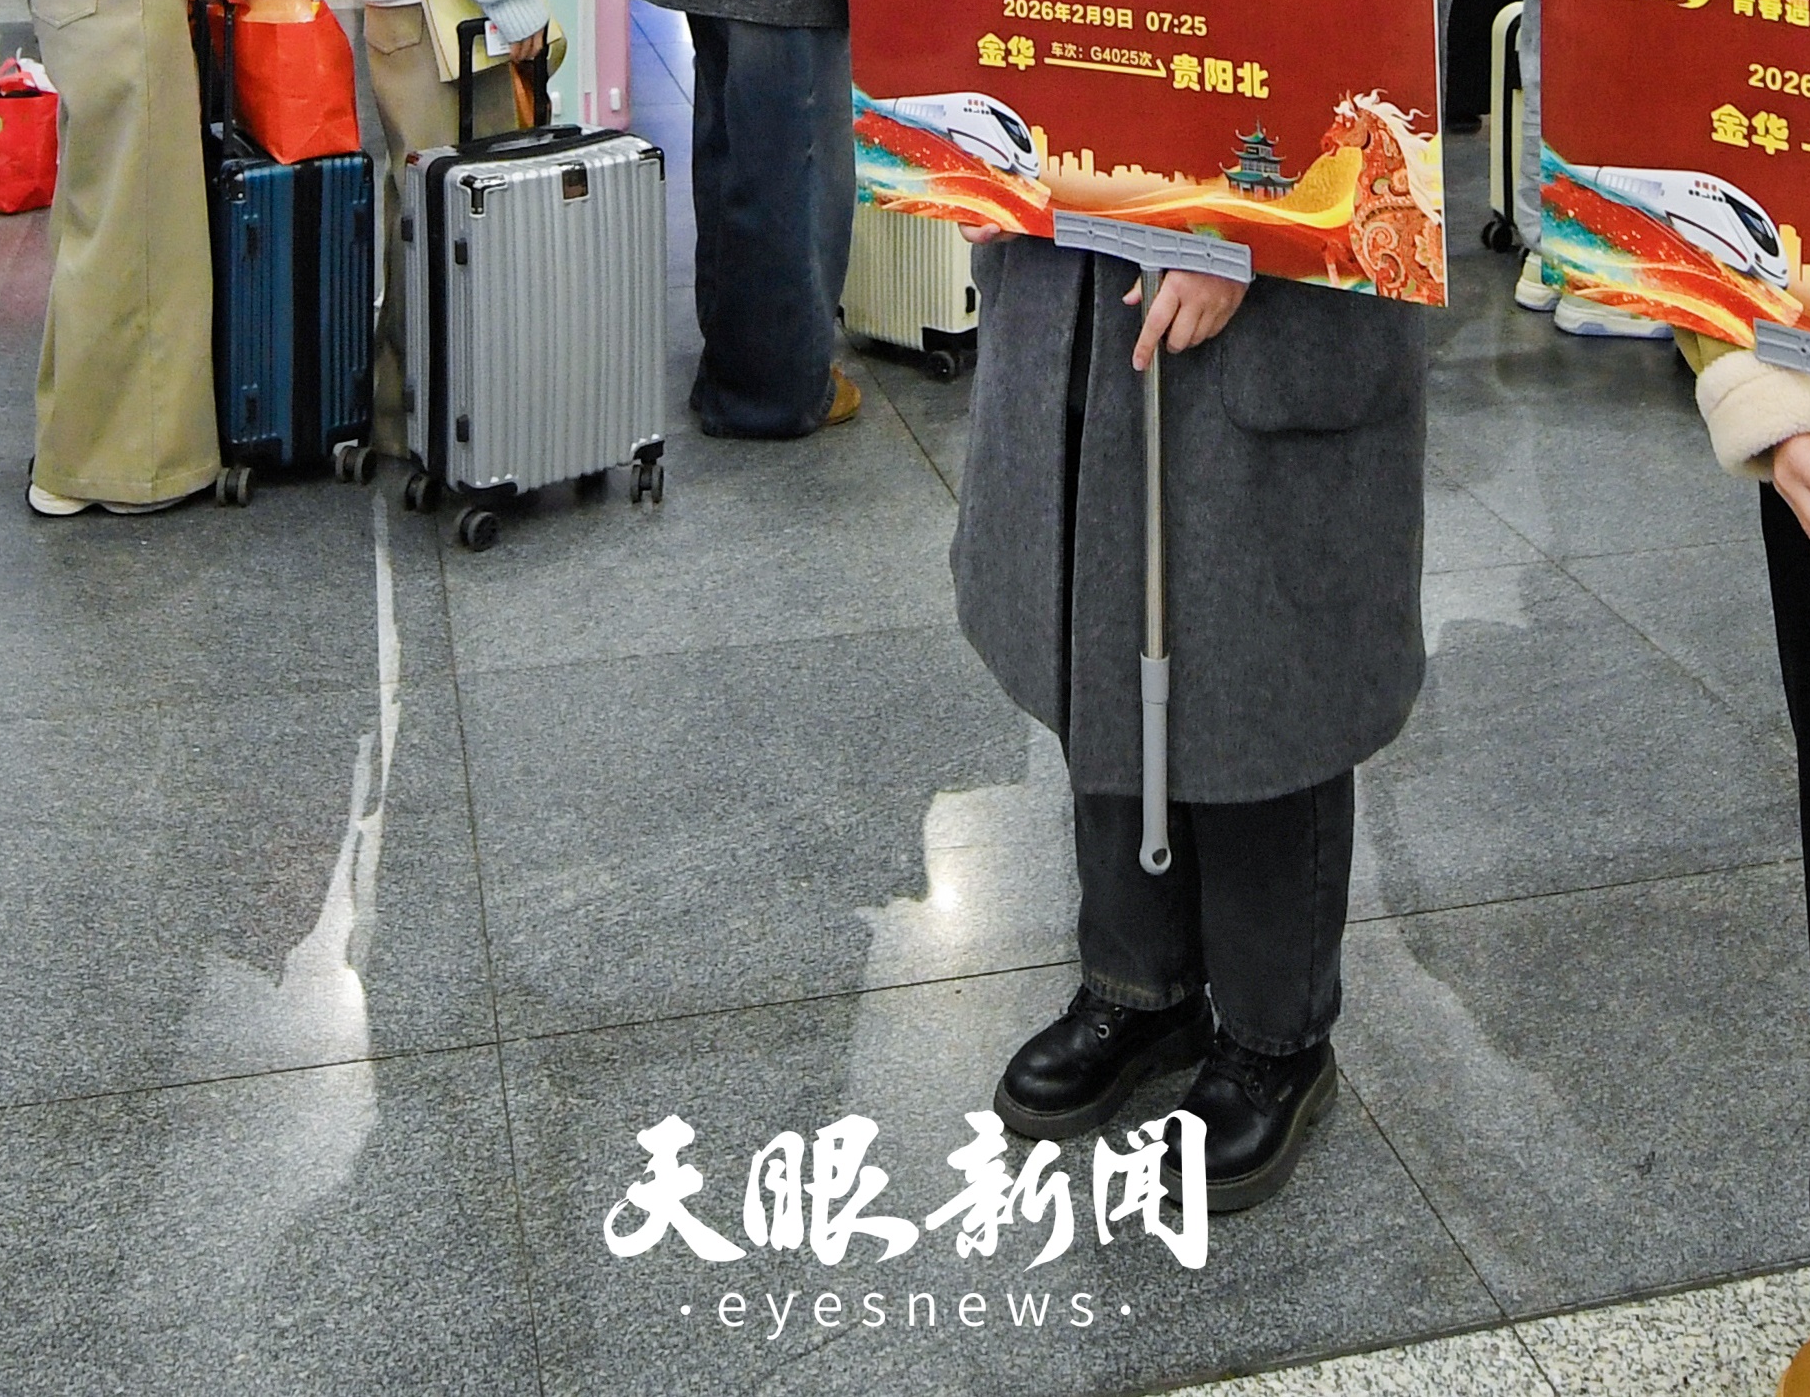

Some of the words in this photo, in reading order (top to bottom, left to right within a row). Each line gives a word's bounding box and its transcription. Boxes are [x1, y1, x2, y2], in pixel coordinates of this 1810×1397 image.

[1146, 11, 1207, 37] 07:25
[977, 33, 1036, 70] 金华
[1170, 54, 1270, 99] 贵阳北
[1710, 104, 1789, 155] 金华
